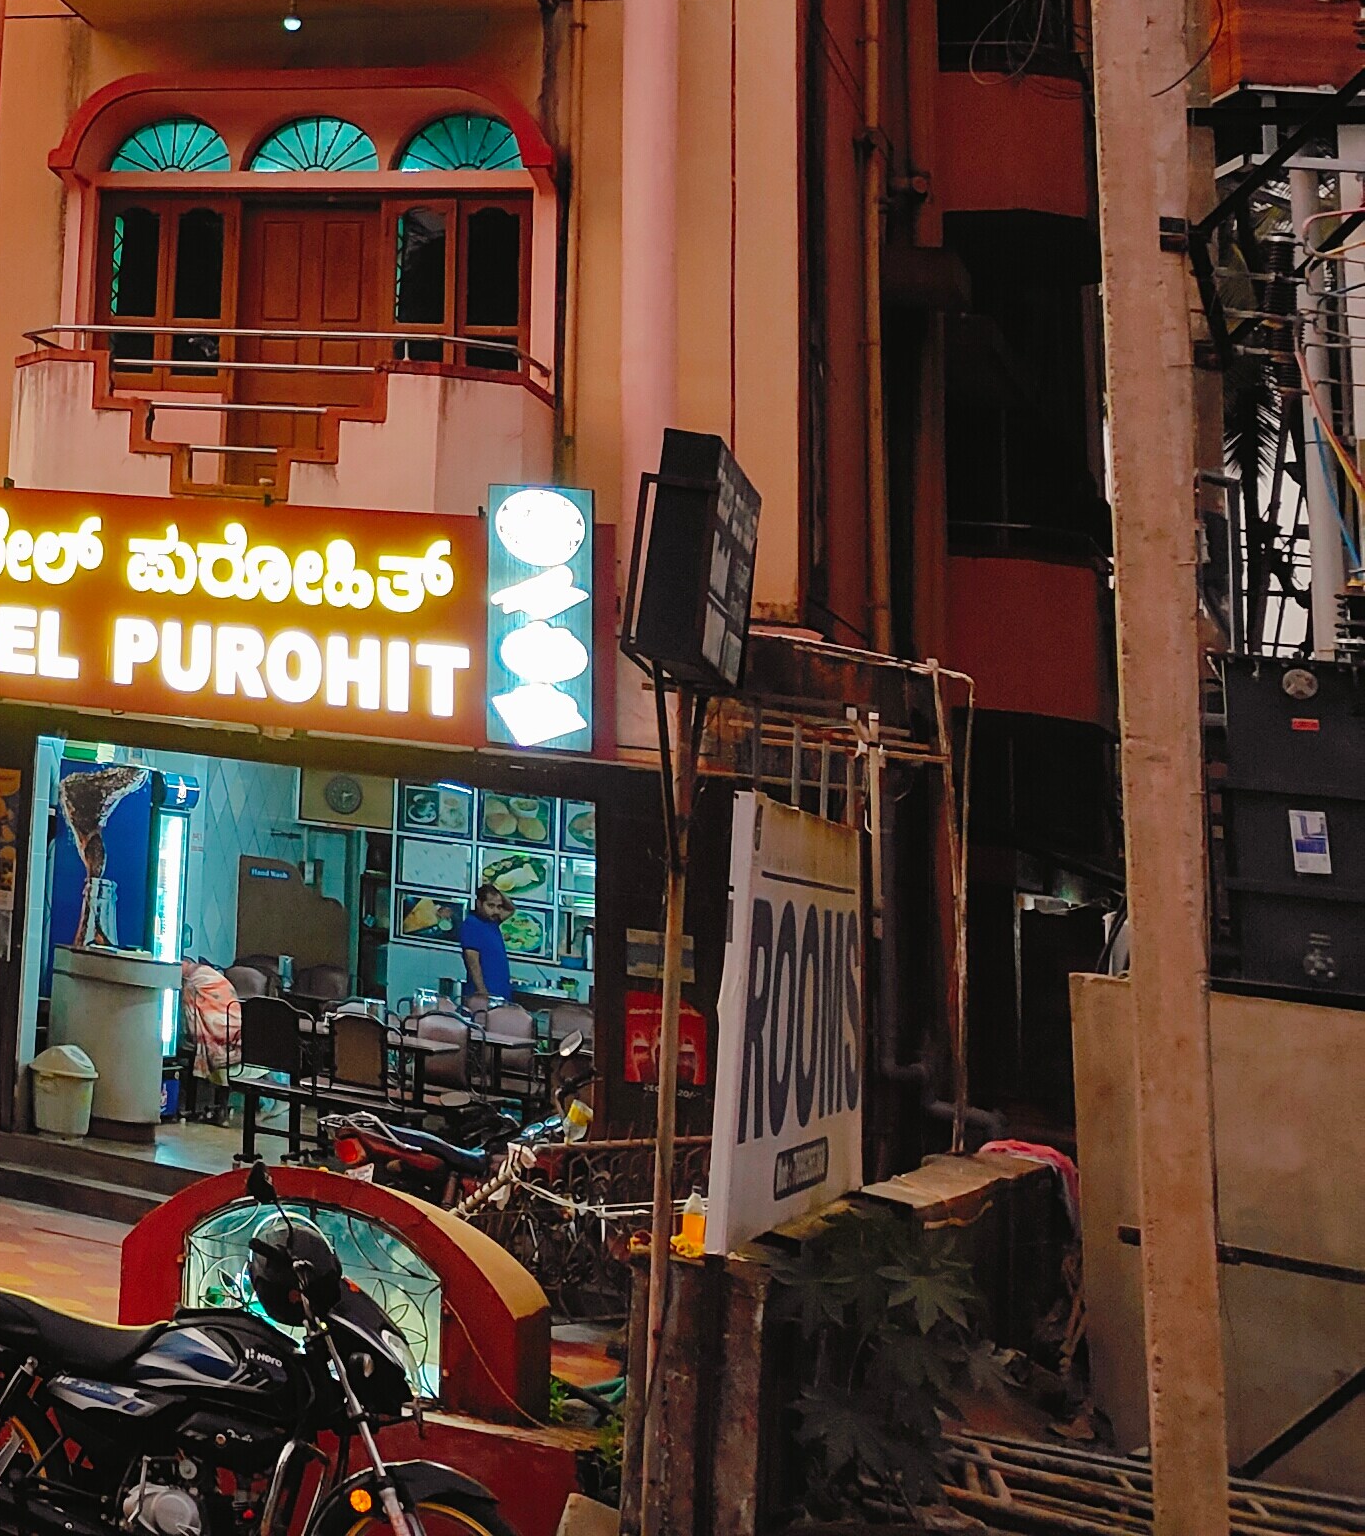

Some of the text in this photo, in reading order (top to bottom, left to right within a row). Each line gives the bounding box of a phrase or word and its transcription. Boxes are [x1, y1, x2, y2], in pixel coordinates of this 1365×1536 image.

[127, 522, 455, 613] ಪುರೋಹಿತ್
[112, 617, 470, 718] PUROHIT
[251, 868, 288, 879] Hand Wash
[737, 898, 862, 1144] ROOMS
[257, 1352, 282, 1367] Hero
